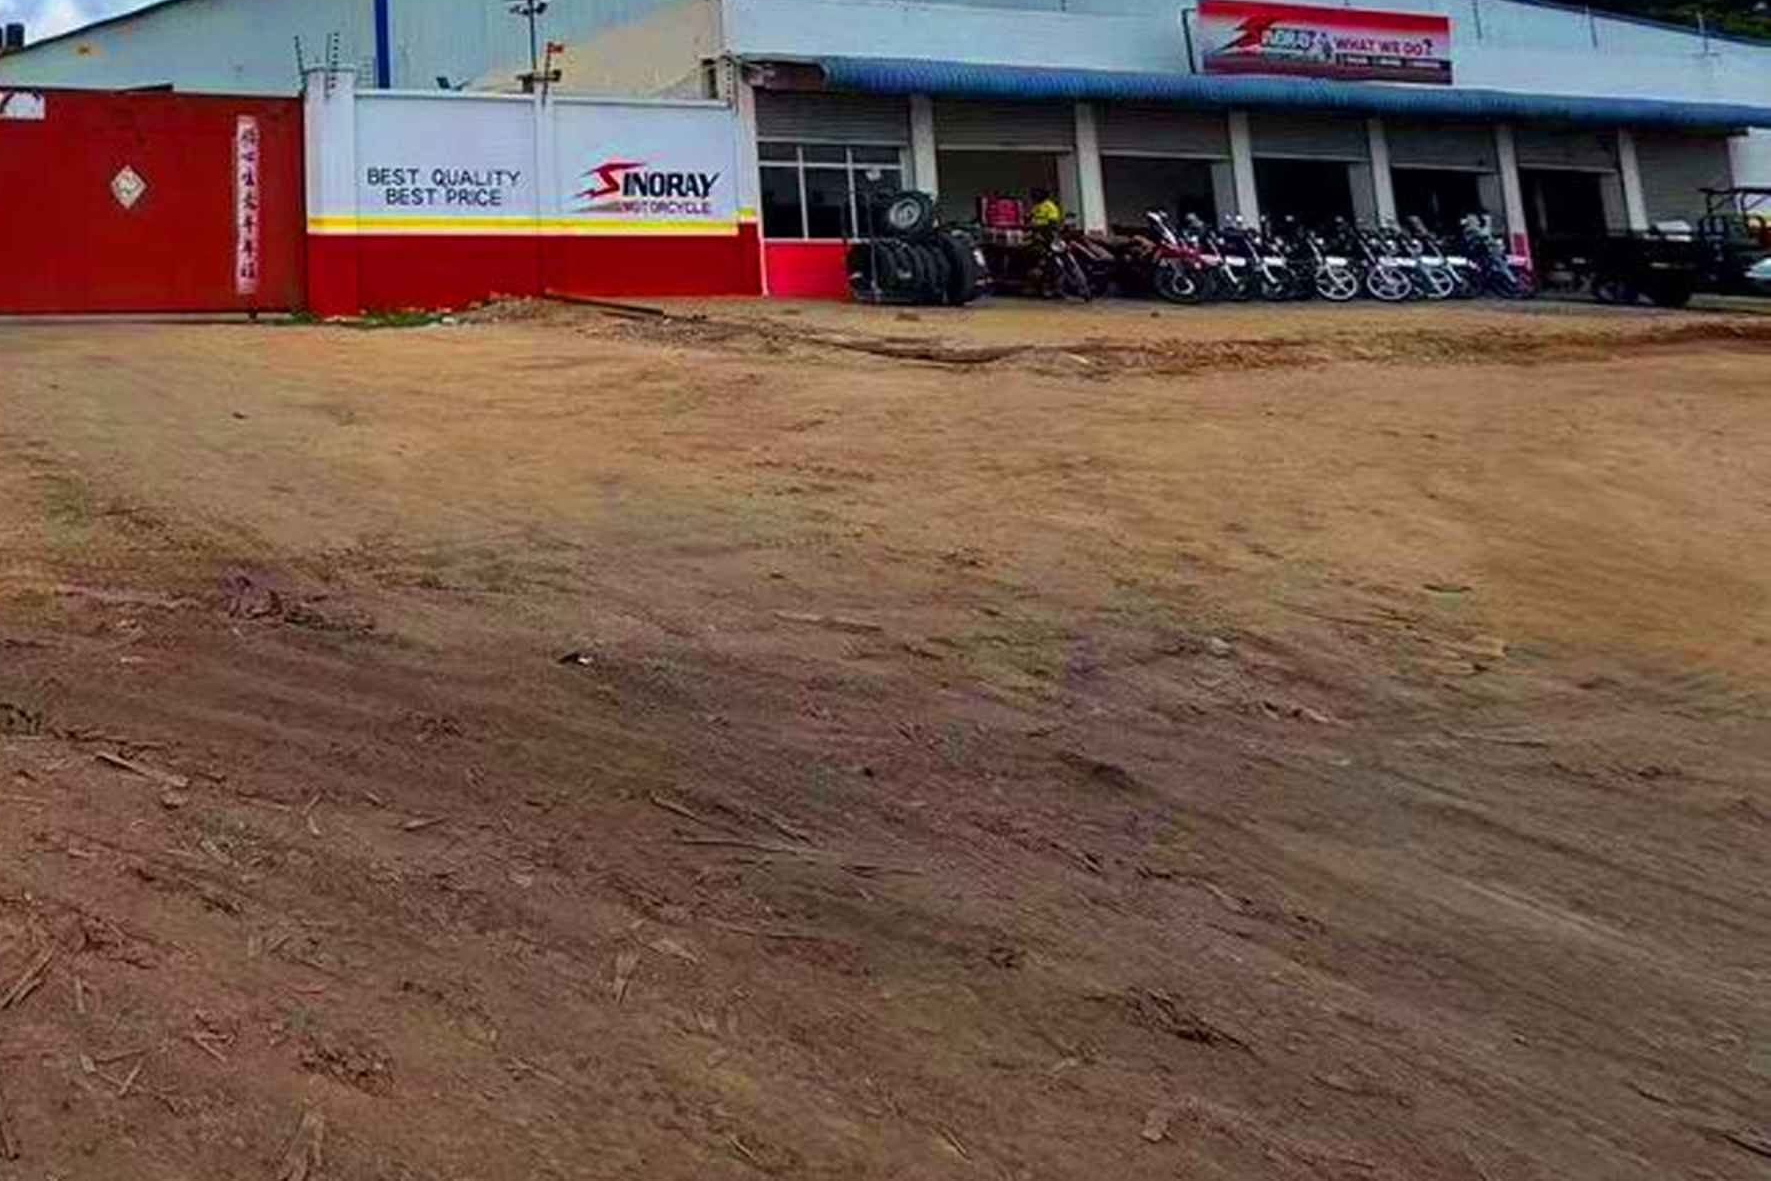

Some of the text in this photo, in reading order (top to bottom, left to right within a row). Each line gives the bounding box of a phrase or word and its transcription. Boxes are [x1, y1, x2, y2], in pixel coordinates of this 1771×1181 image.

[366, 168, 521, 187] BEST QUALITY
[575, 162, 720, 198] SINORAY
[386, 188, 501, 206] BEST PRICE
[619, 201, 710, 214] MOTORCYCLE
